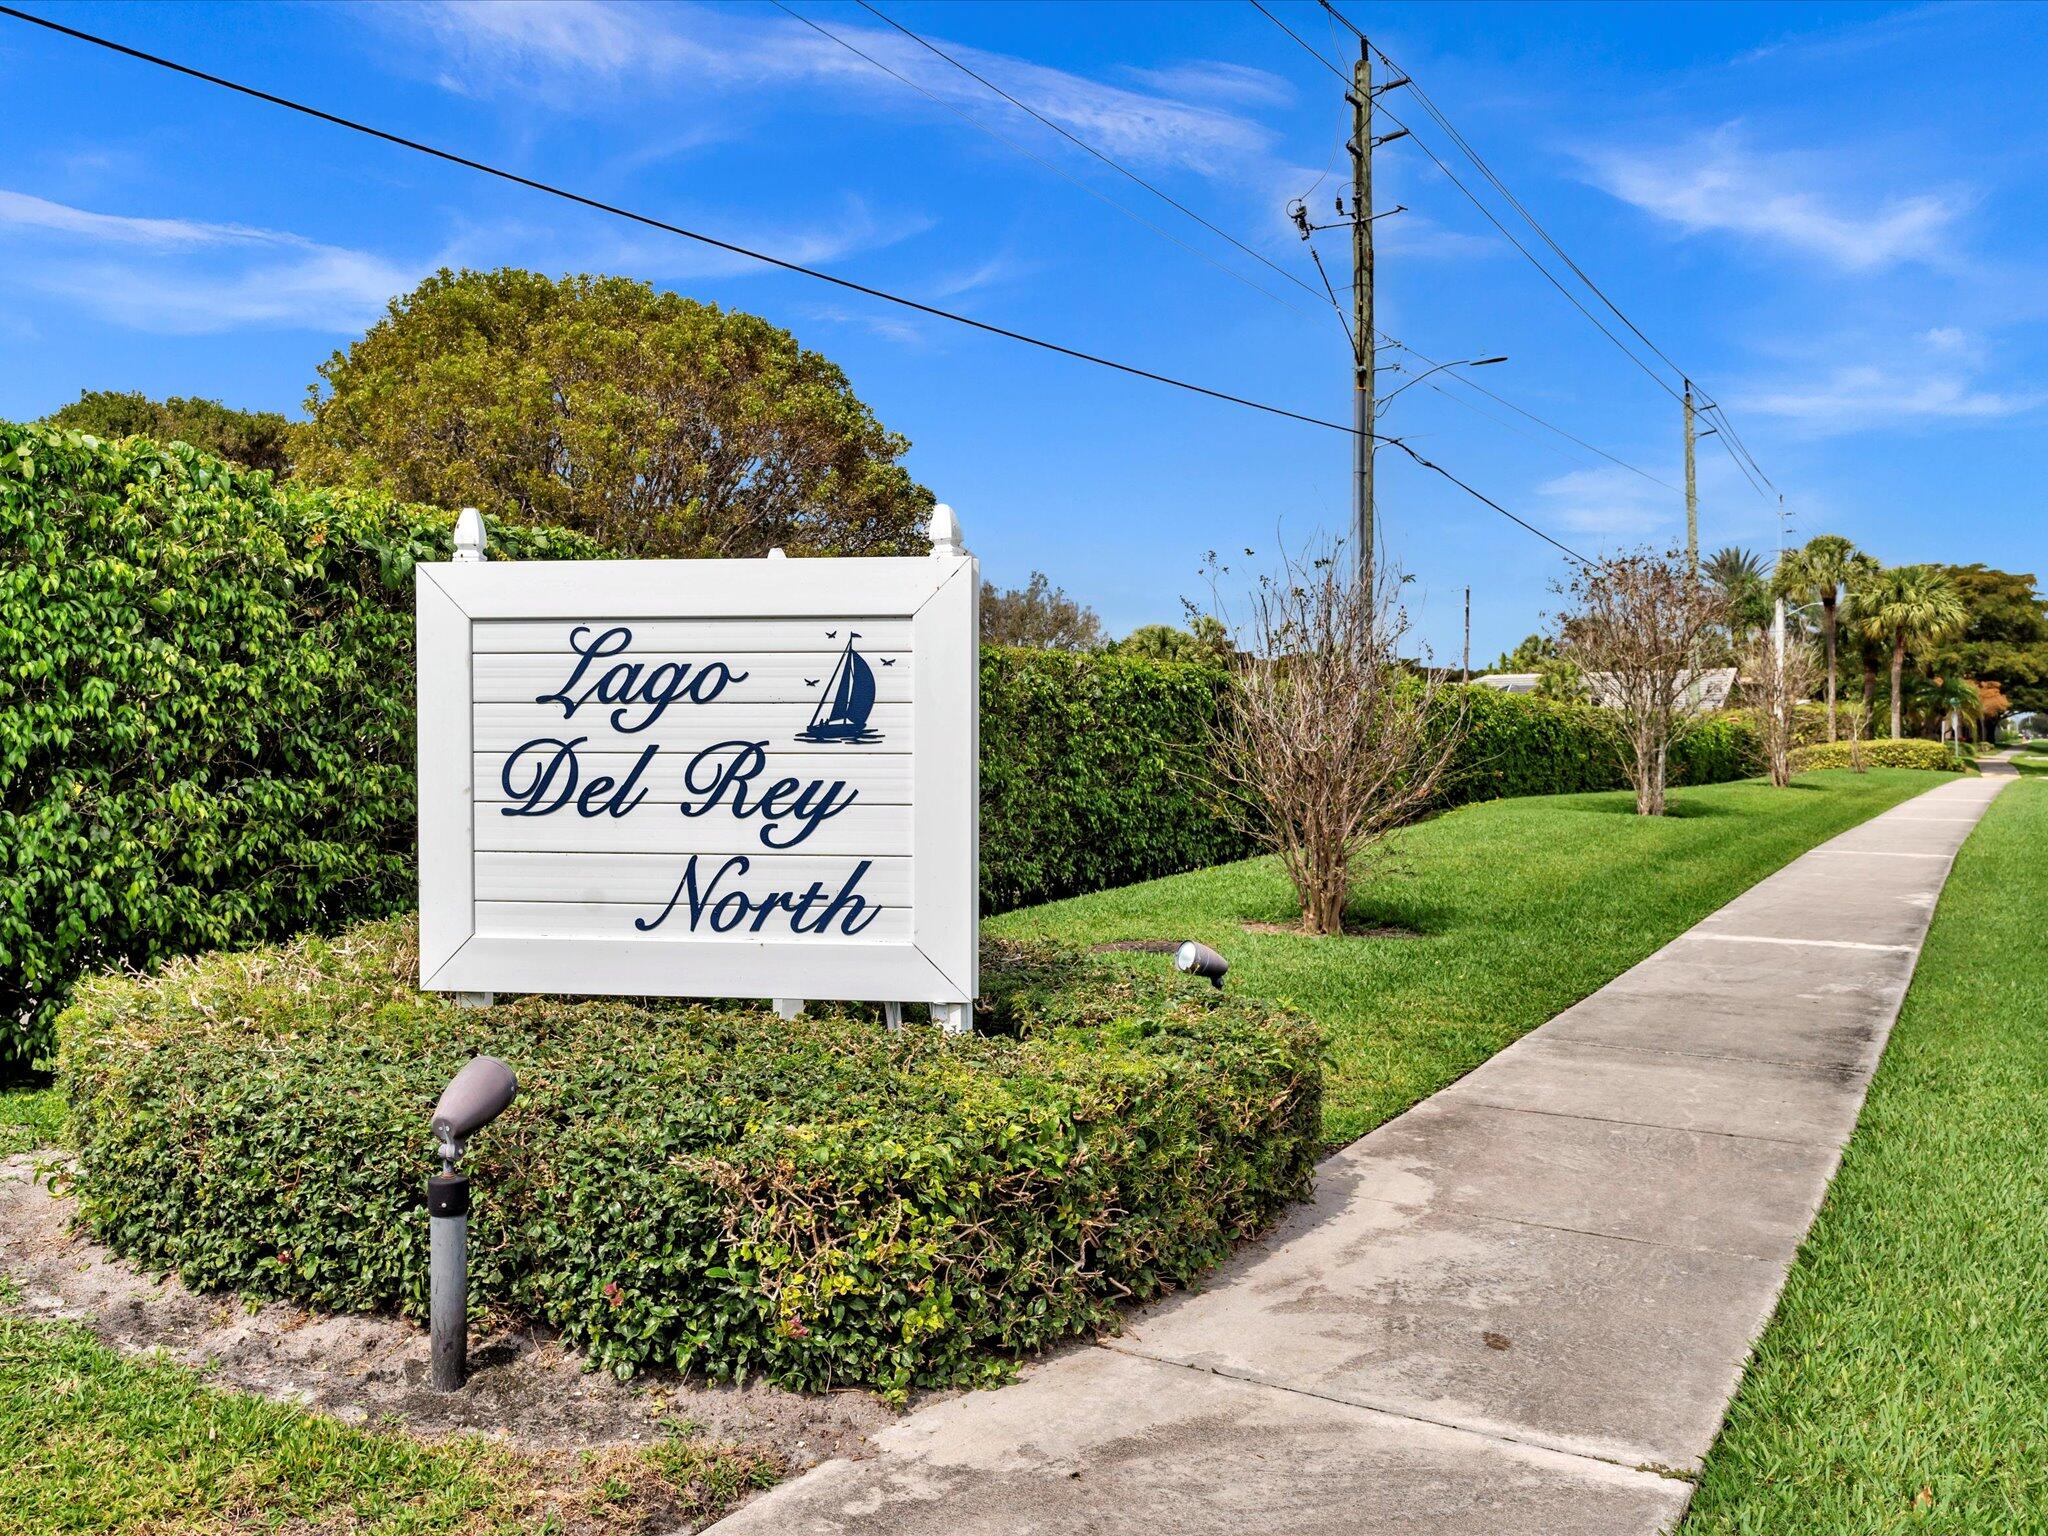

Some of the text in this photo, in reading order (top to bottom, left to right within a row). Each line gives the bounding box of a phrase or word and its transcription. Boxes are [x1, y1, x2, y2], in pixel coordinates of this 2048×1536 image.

[536, 626, 748, 733] Lago
[502, 736, 859, 849] Del Rey
[635, 855, 882, 935] North
